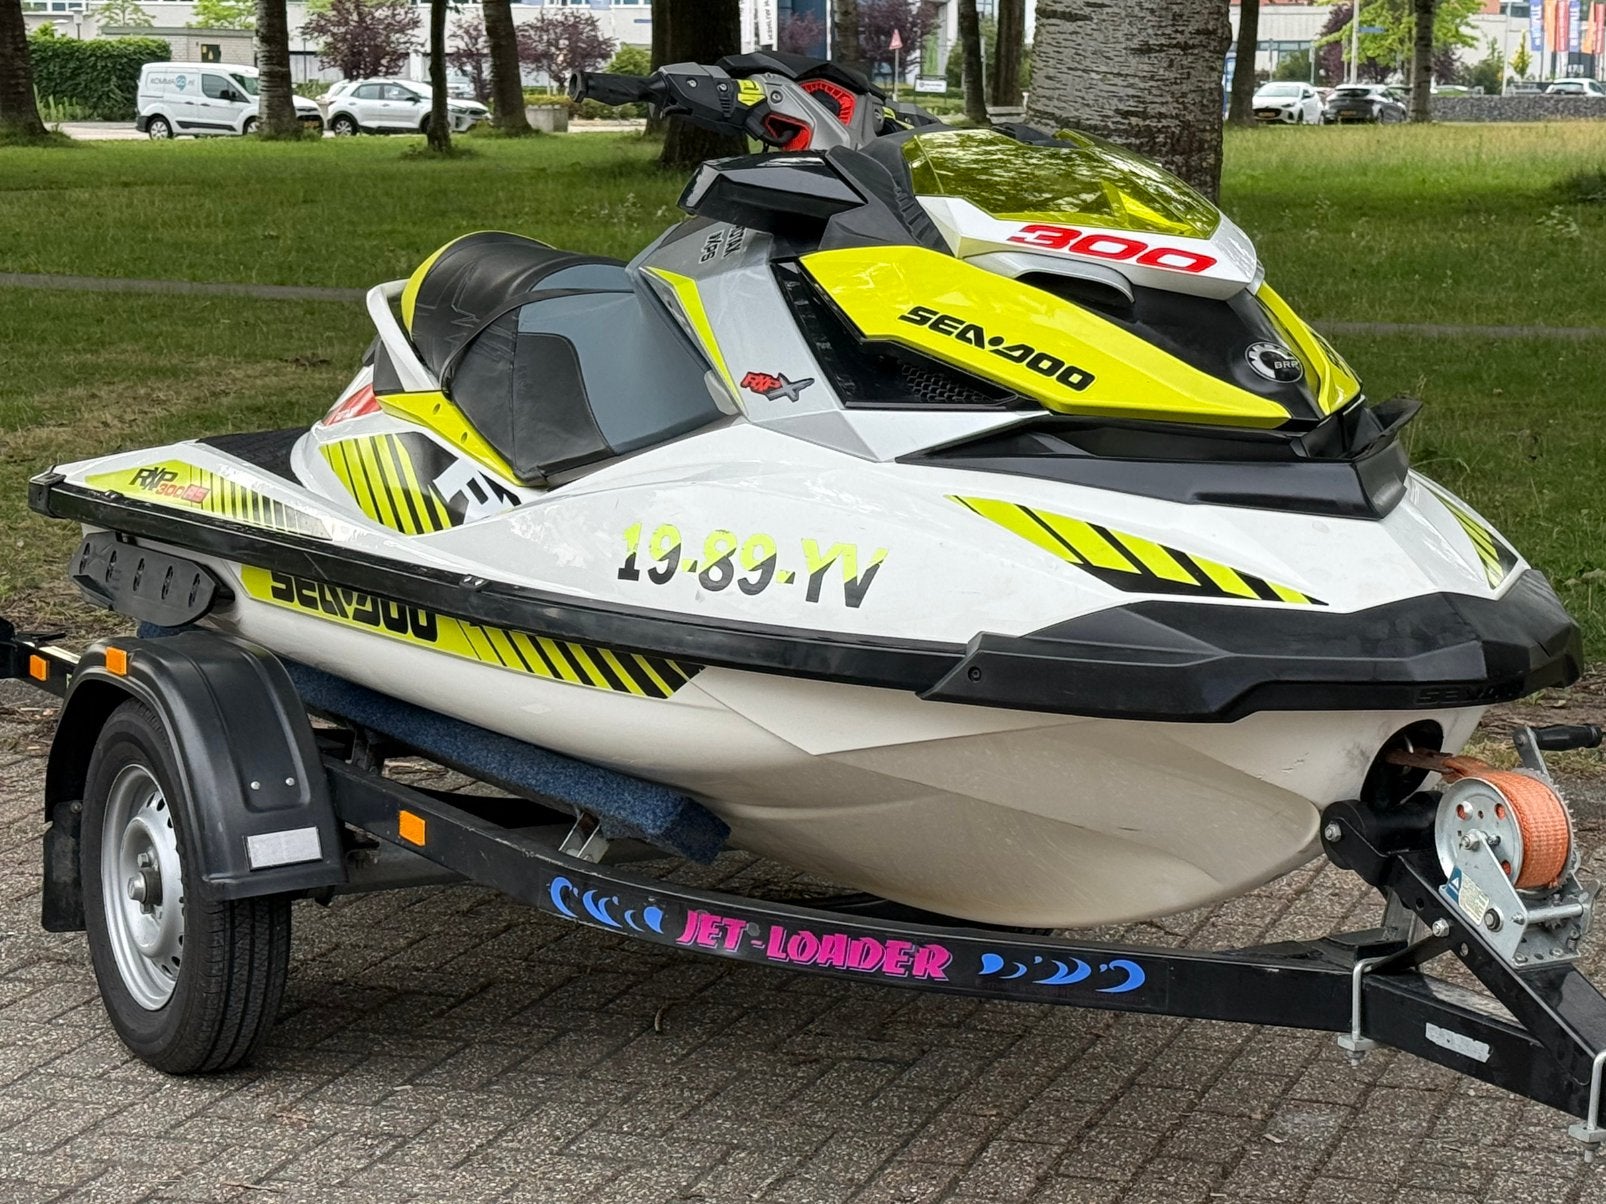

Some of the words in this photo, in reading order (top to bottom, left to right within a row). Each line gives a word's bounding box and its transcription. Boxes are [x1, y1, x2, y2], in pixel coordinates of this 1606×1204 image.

[1006, 224, 1218, 273] 300
[1274, 359, 1300, 371] BRP
[128, 466, 178, 491] RXP
[156, 483, 185, 498] 300
[617, 521, 889, 608] 19-89-YV
[676, 909, 952, 981] JET-LOADER
